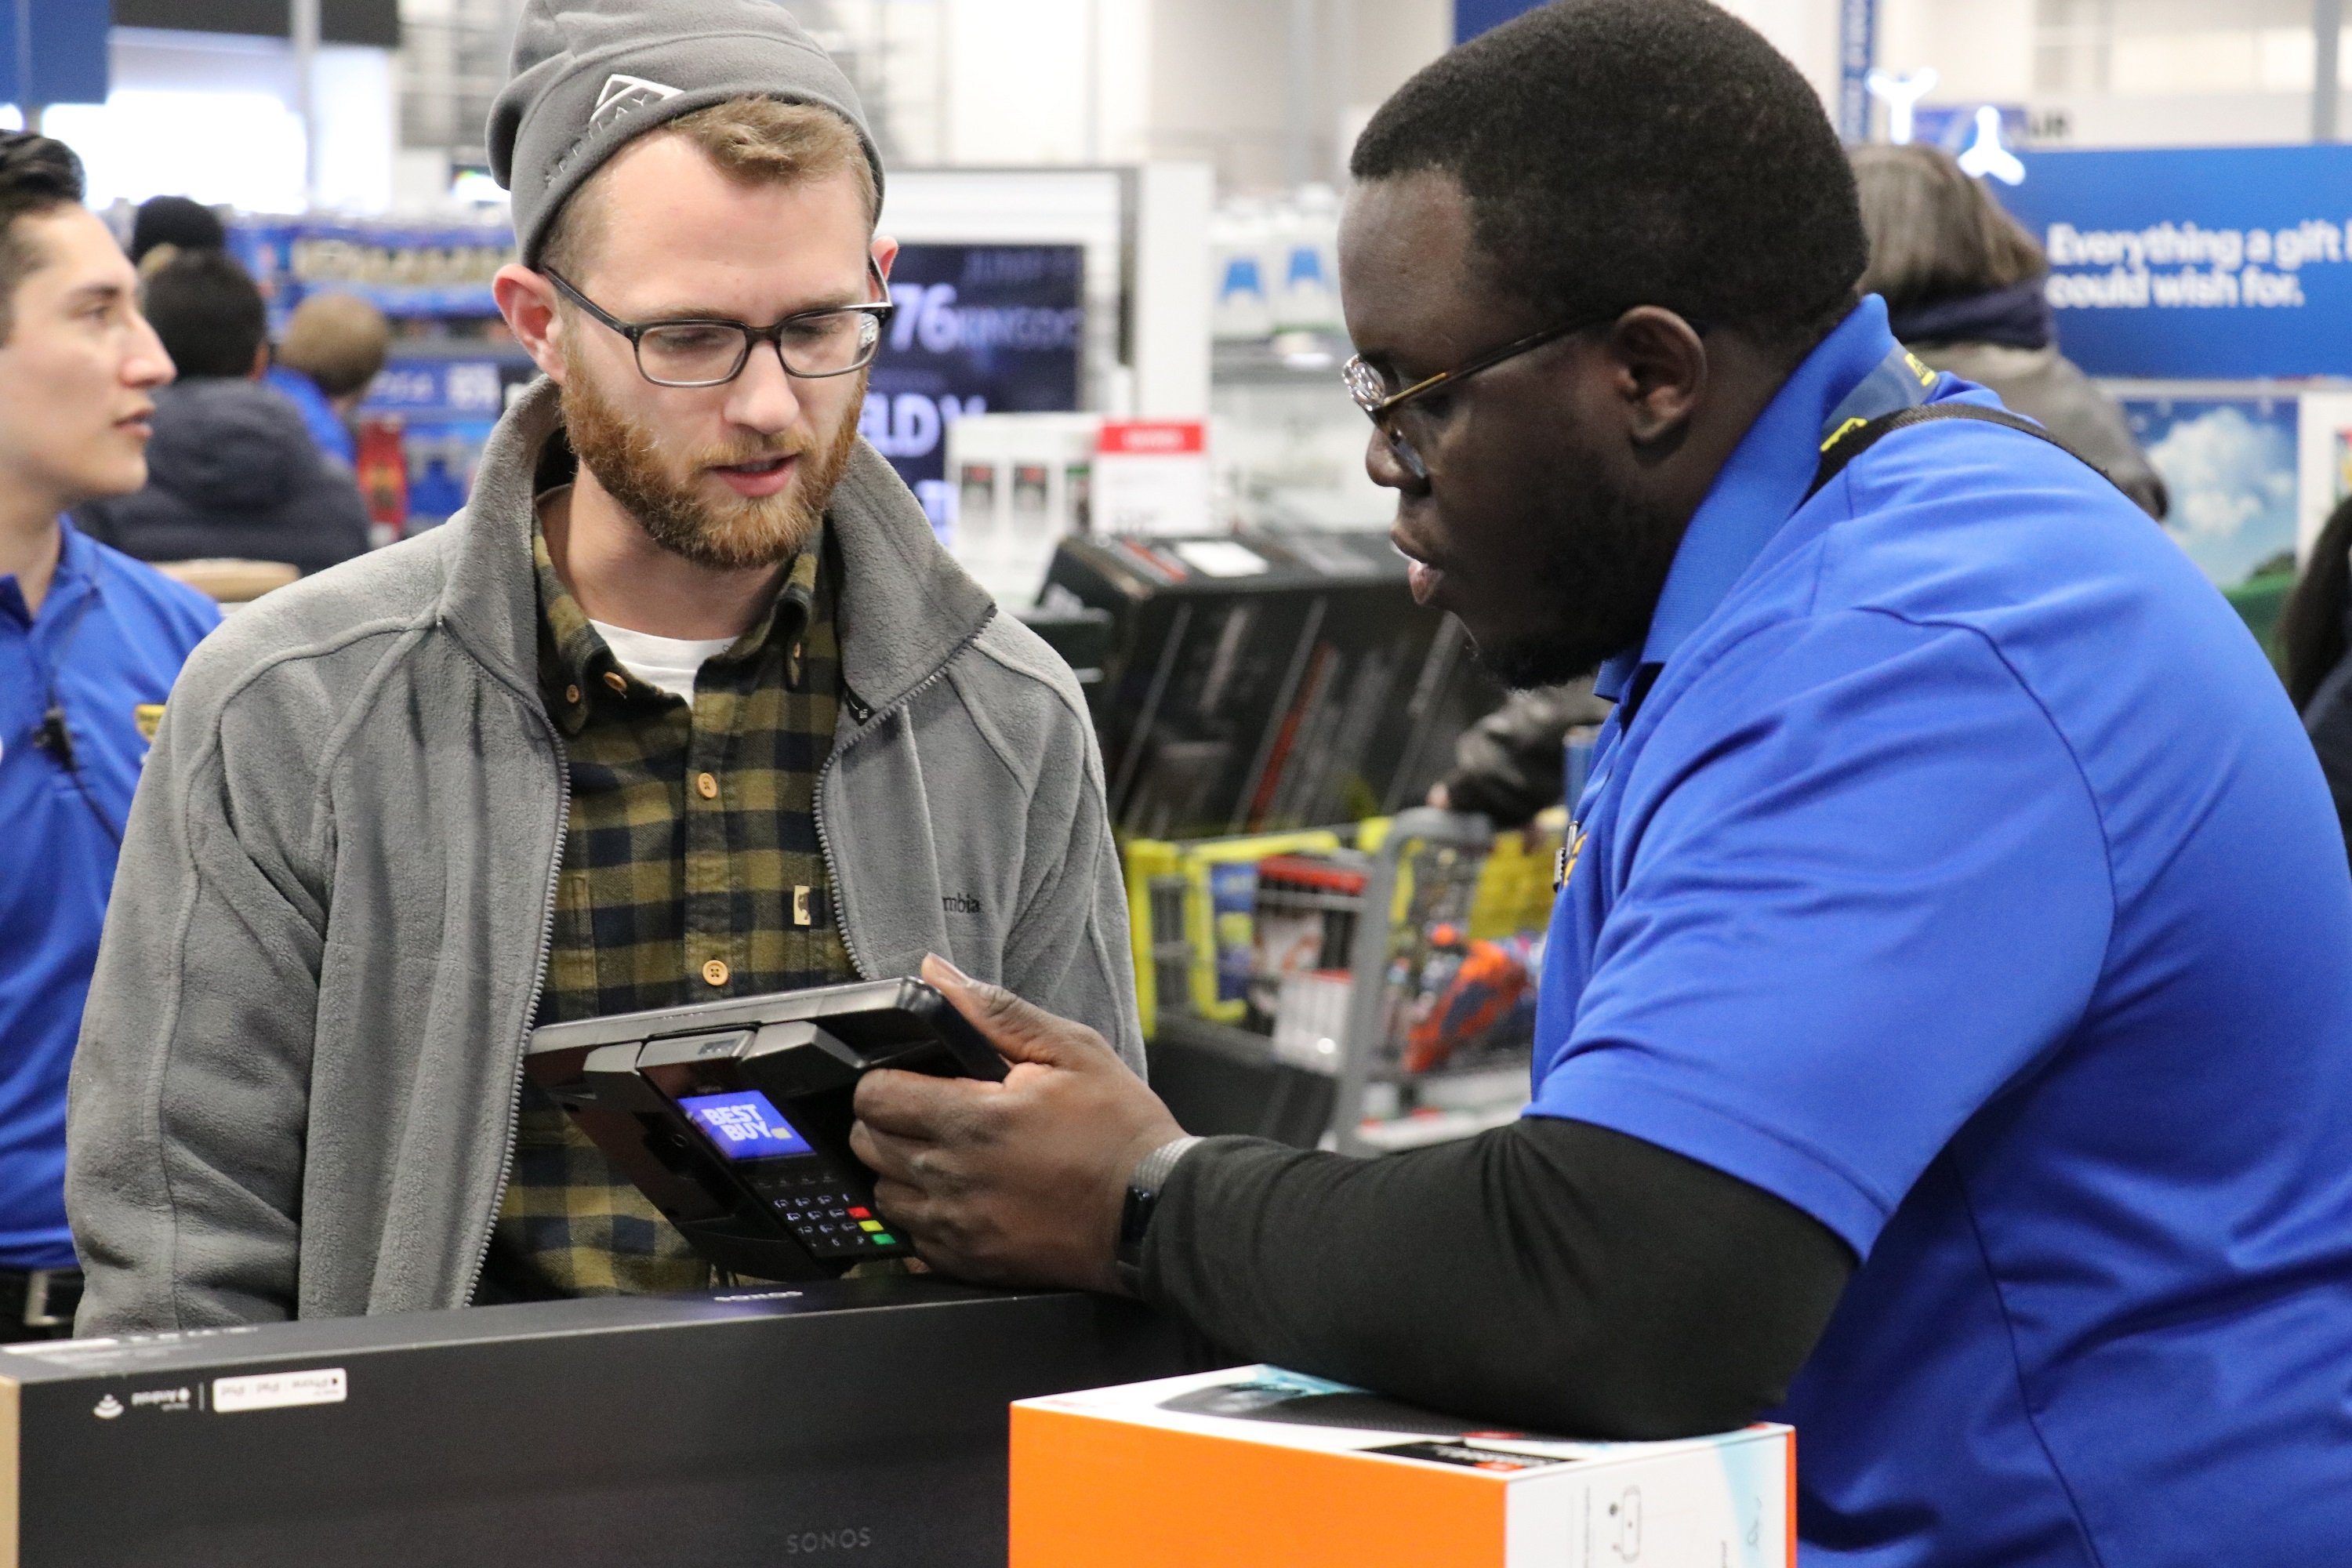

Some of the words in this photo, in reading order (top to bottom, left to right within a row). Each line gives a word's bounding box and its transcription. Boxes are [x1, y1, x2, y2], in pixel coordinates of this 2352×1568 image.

[2048, 223, 2243, 272] Everything
[2246, 229, 2271, 263] a
[2275, 220, 2342, 270] gift
[2044, 266, 2151, 309] could
[2153, 266, 2238, 307] wish
[2241, 265, 2305, 307] for.
[889, 283, 957, 353] 76
[701, 1104, 763, 1125] BEST
[720, 1121, 772, 1141] BUY
[786, 1527, 871, 1554] SONOS
